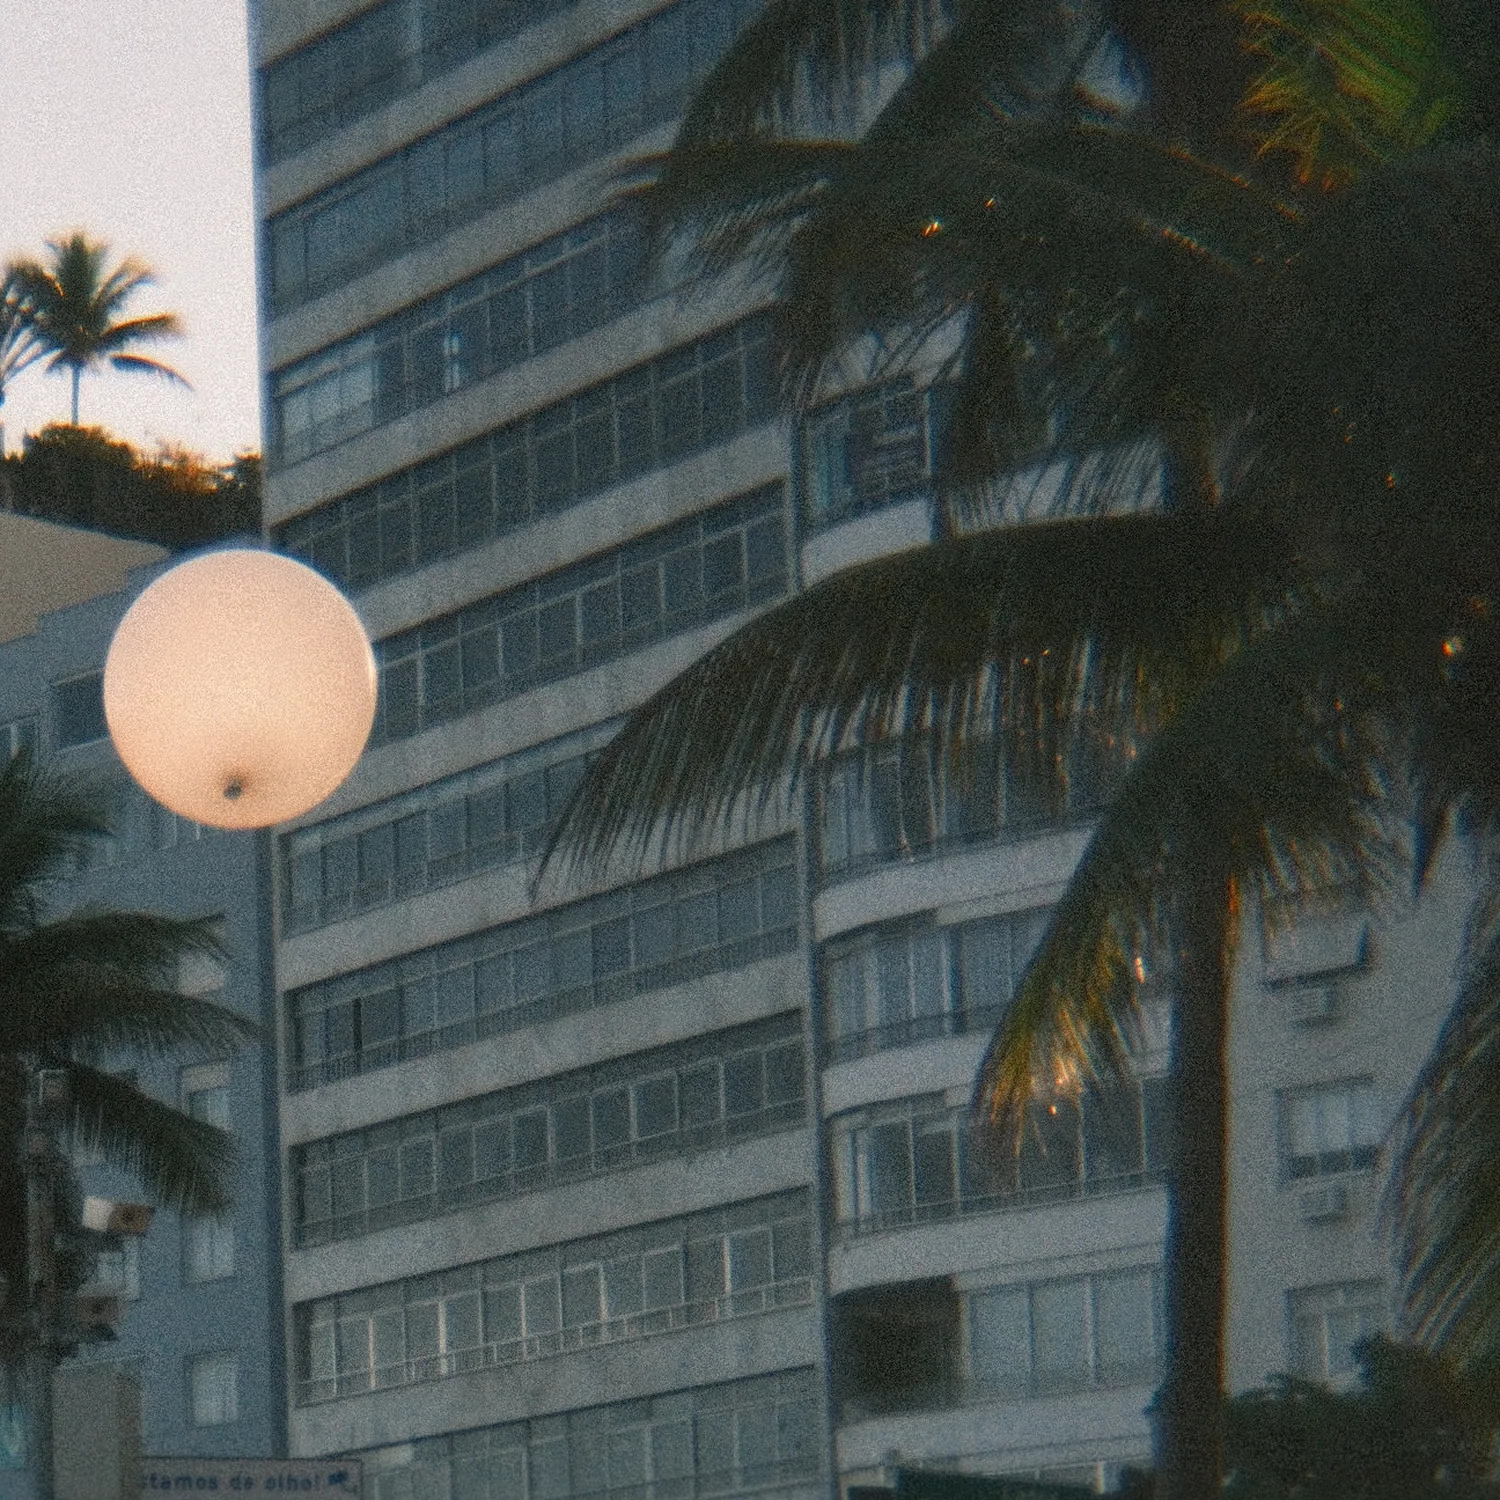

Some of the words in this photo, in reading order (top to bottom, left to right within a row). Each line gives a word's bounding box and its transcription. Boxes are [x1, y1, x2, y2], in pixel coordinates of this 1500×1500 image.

[141, 1473, 219, 1491] tamos
[230, 1473, 254, 1491] de
[265, 1474, 321, 1491] olho!
